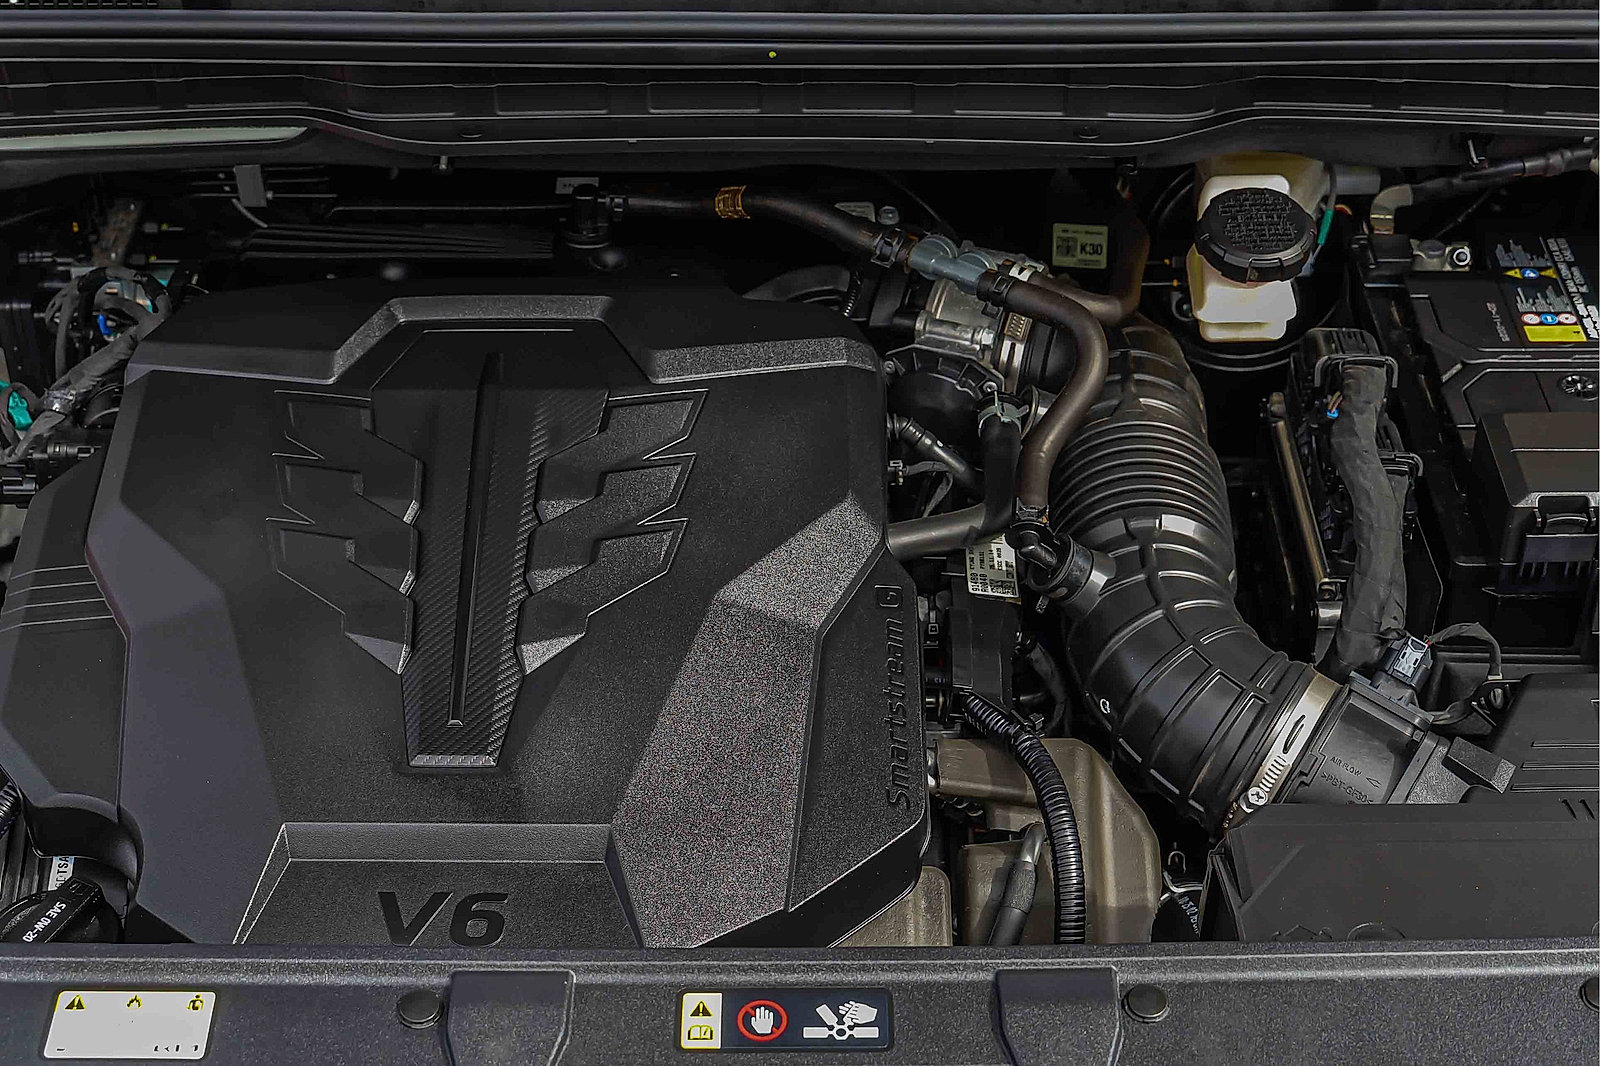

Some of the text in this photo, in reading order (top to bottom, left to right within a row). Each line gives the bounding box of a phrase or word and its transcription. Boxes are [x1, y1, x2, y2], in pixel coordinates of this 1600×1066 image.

[1080, 242, 1103, 256] K30
[882, 618, 911, 810] Smartstream
[1330, 756, 1342, 767] AIR
[46, 901, 67, 919] SAE
[377, 891, 510, 948] V6
[22, 917, 52, 942] 0W-20
